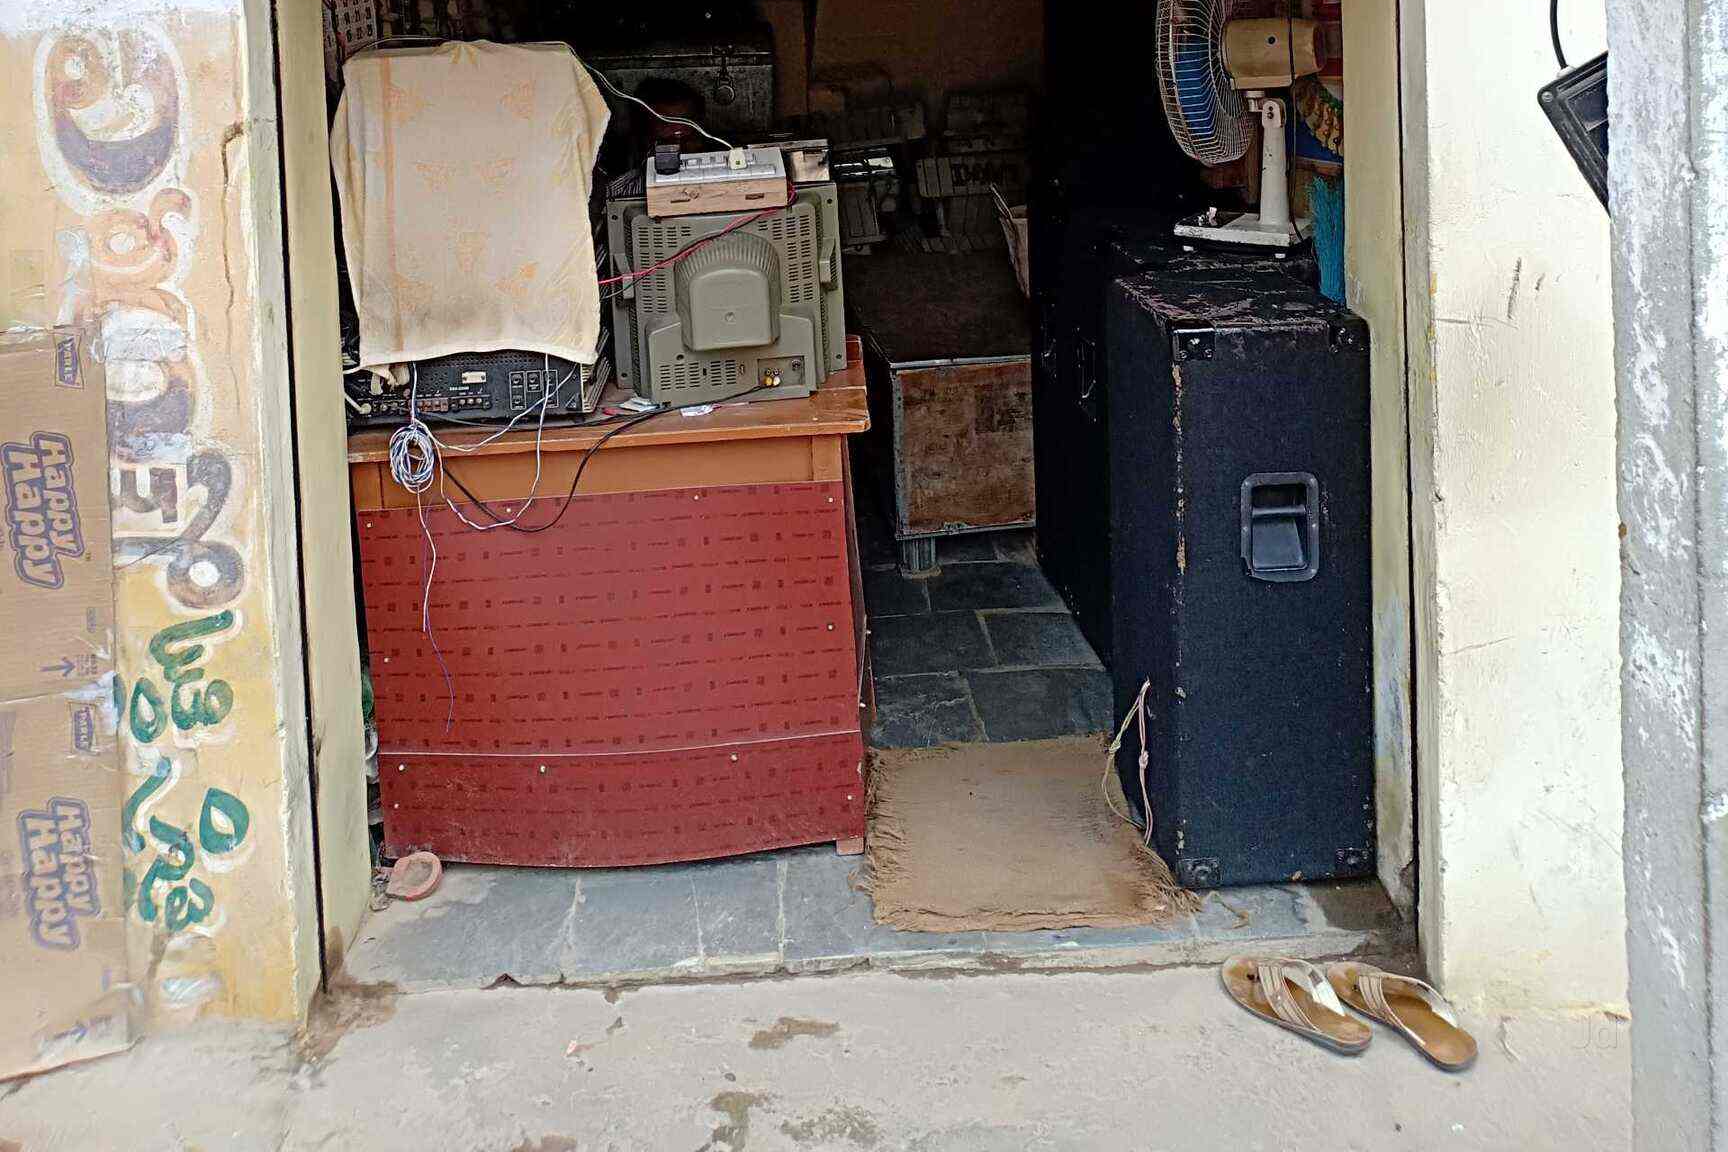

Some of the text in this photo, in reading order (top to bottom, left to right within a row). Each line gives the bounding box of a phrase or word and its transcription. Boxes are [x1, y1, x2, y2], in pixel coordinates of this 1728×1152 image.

[8, 450, 57, 586] Happy
[39, 438, 76, 552] Happy
[24, 816, 72, 946] Happy
[54, 803, 93, 913] Happy
